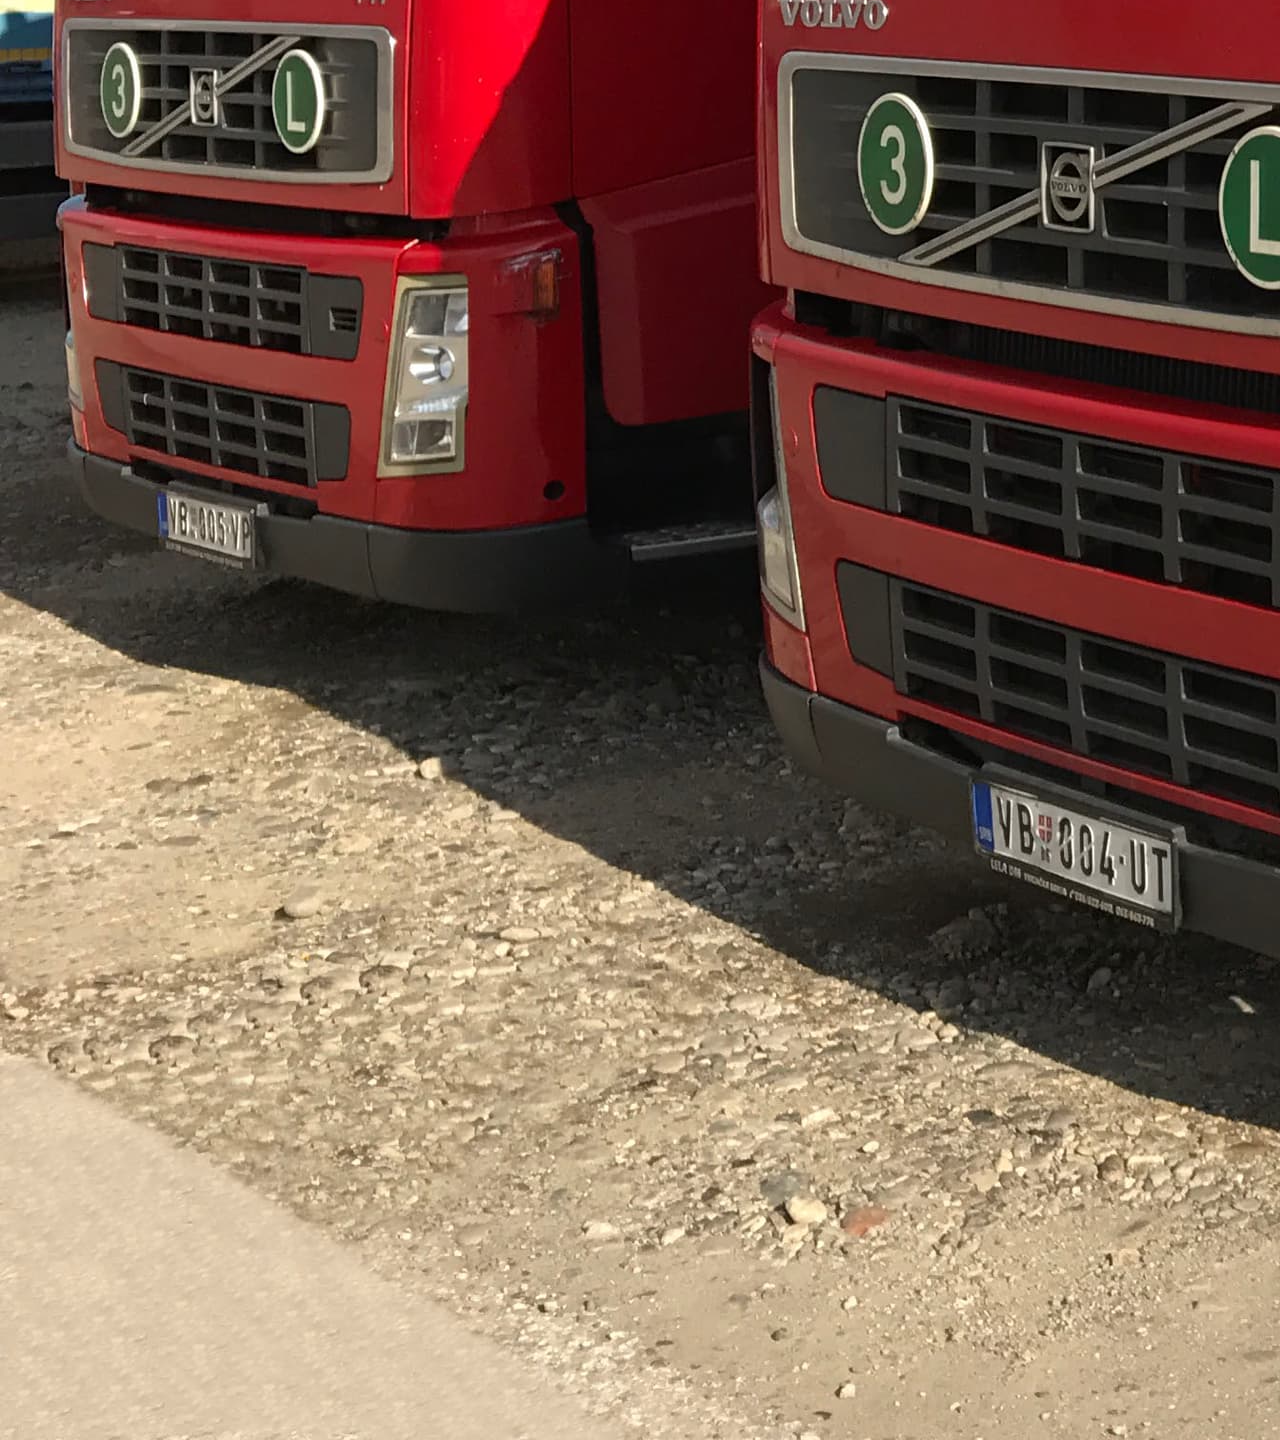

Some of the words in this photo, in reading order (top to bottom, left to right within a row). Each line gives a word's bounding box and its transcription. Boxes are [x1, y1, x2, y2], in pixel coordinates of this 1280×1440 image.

[111, 64, 126, 118] 3
[286, 71, 306, 133] L
[880, 124, 906, 205] 3
[1051, 181, 1087, 193] VOLVO
[997, 797, 1036, 855] VB
